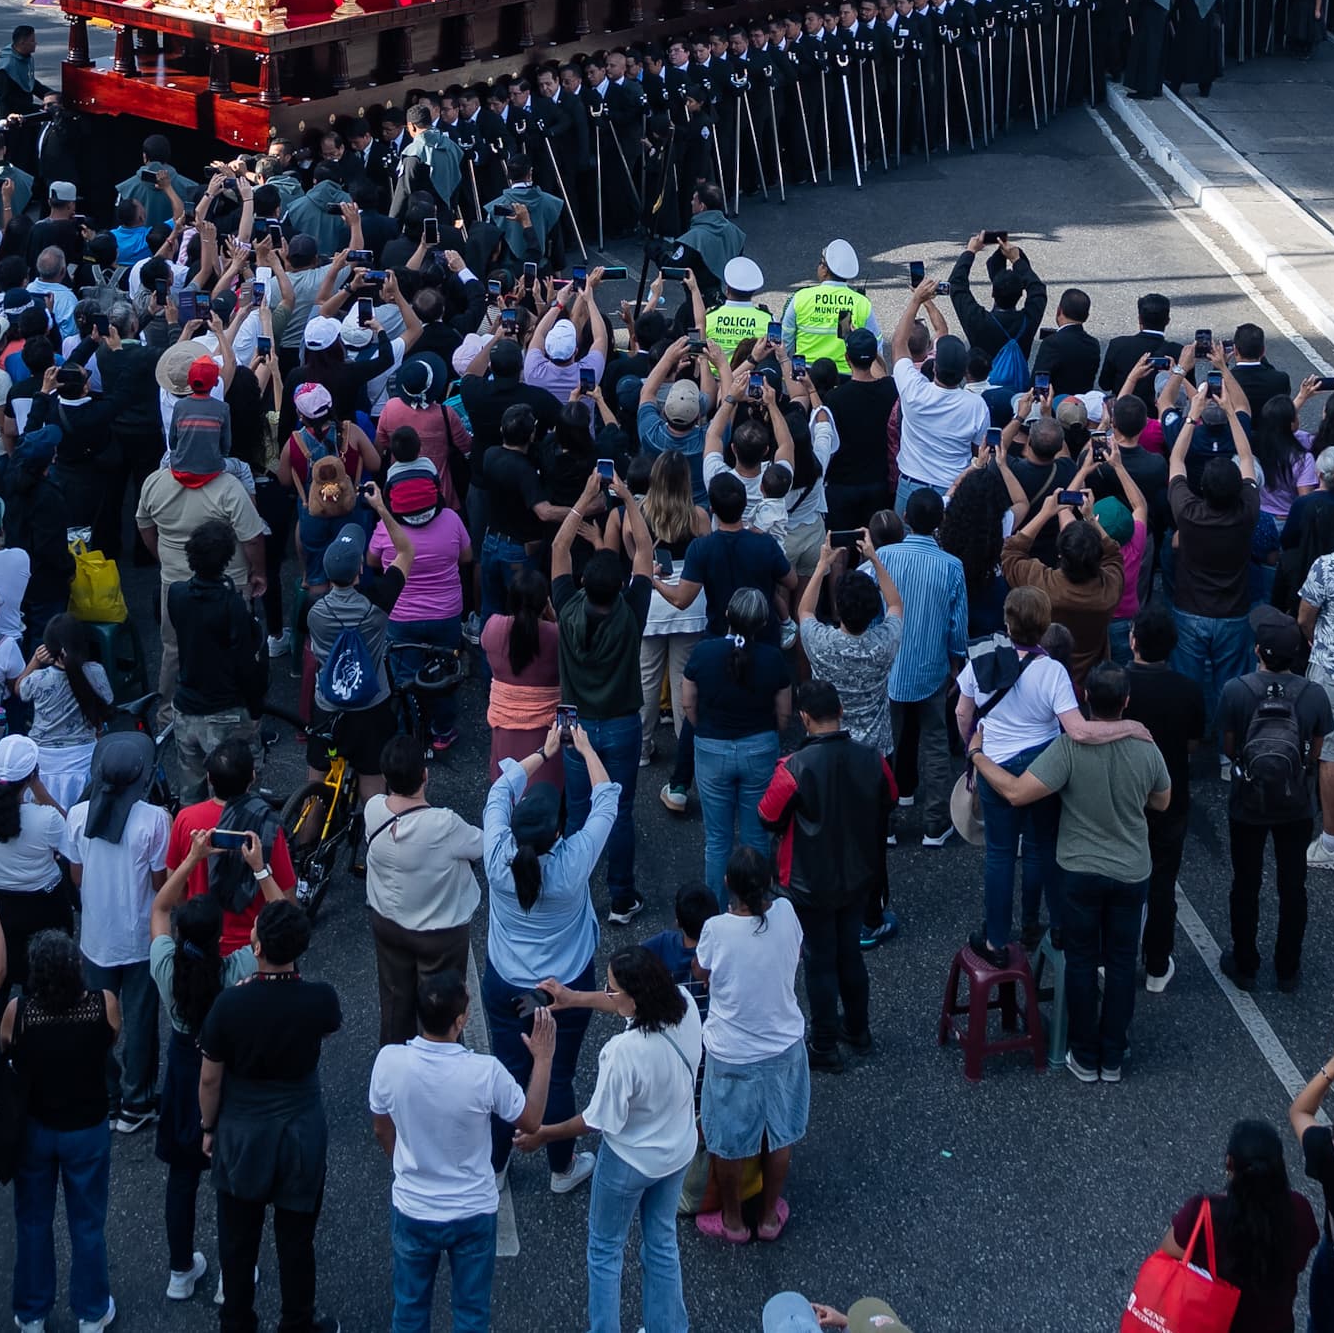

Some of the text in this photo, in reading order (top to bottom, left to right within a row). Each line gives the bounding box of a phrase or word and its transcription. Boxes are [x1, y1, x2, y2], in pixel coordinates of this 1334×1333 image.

[815, 294, 854, 306] POLICIA
[717, 316, 756, 327] POLICIA
[715, 327, 755, 336] MUNICIPAL
